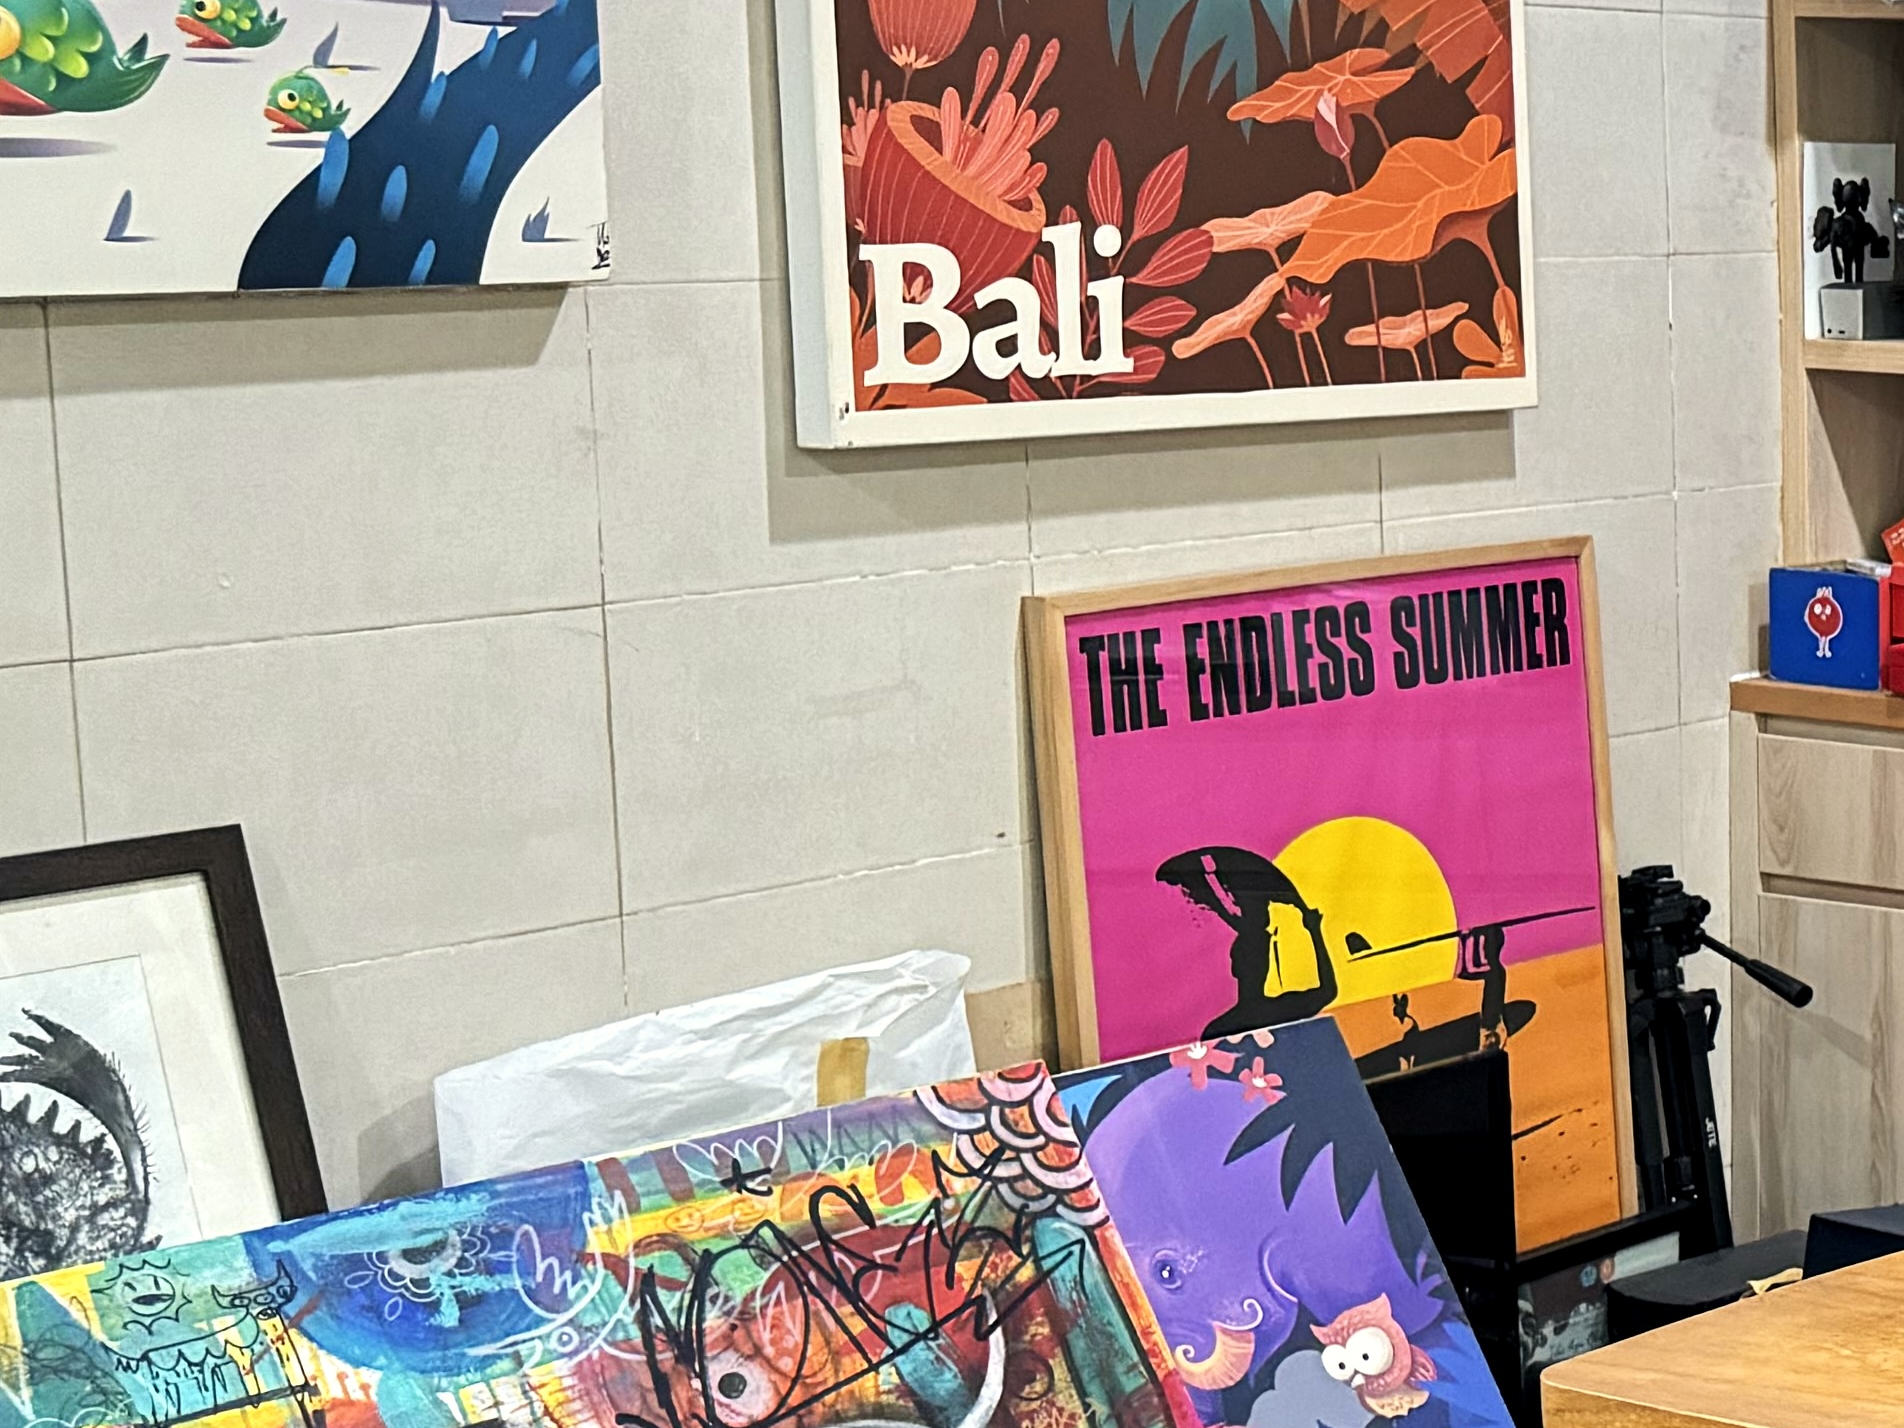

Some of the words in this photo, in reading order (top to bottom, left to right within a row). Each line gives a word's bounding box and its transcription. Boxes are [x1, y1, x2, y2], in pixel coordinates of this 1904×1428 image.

[860, 223, 1133, 388] Bali
[1078, 629, 1169, 736] THE
[1184, 599, 1378, 723] ENDLESS
[1391, 577, 1571, 691] SUMMER
[1704, 1116, 1717, 1149] JETE
